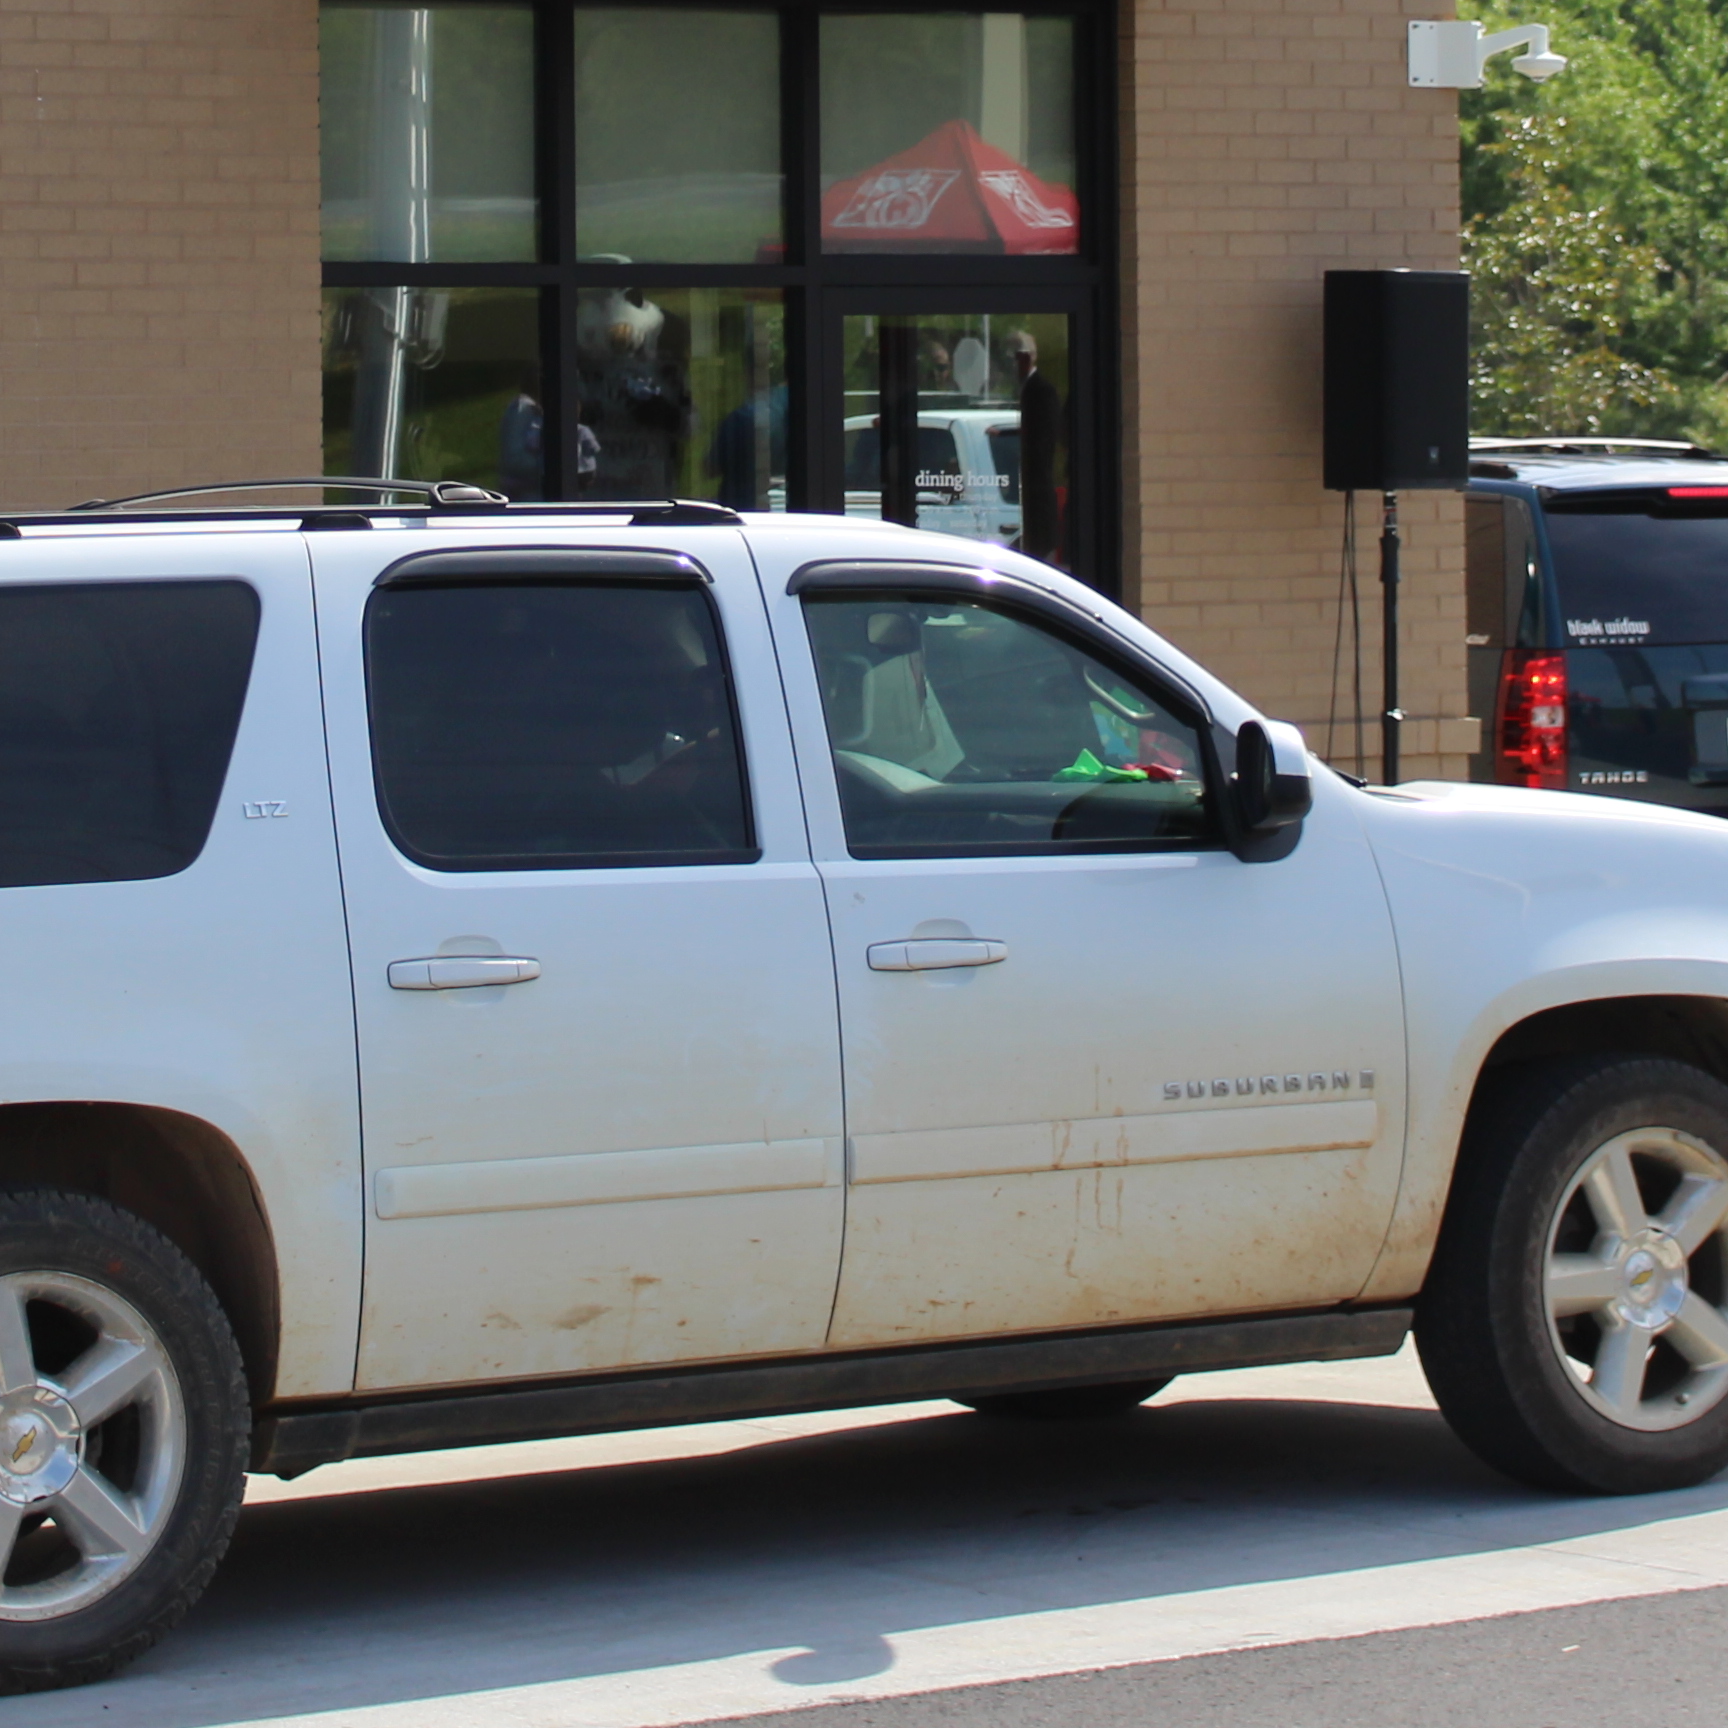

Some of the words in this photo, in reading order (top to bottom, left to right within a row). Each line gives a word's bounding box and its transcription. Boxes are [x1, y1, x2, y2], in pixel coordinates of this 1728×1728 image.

[914, 470, 964, 491] dining
[967, 471, 1010, 486] hours
[1604, 616, 1651, 635] widow
[1579, 770, 1648, 784] TAHOE
[242, 801, 289, 819] LTZ
[1163, 1071, 1351, 1101] SUBURBAN
